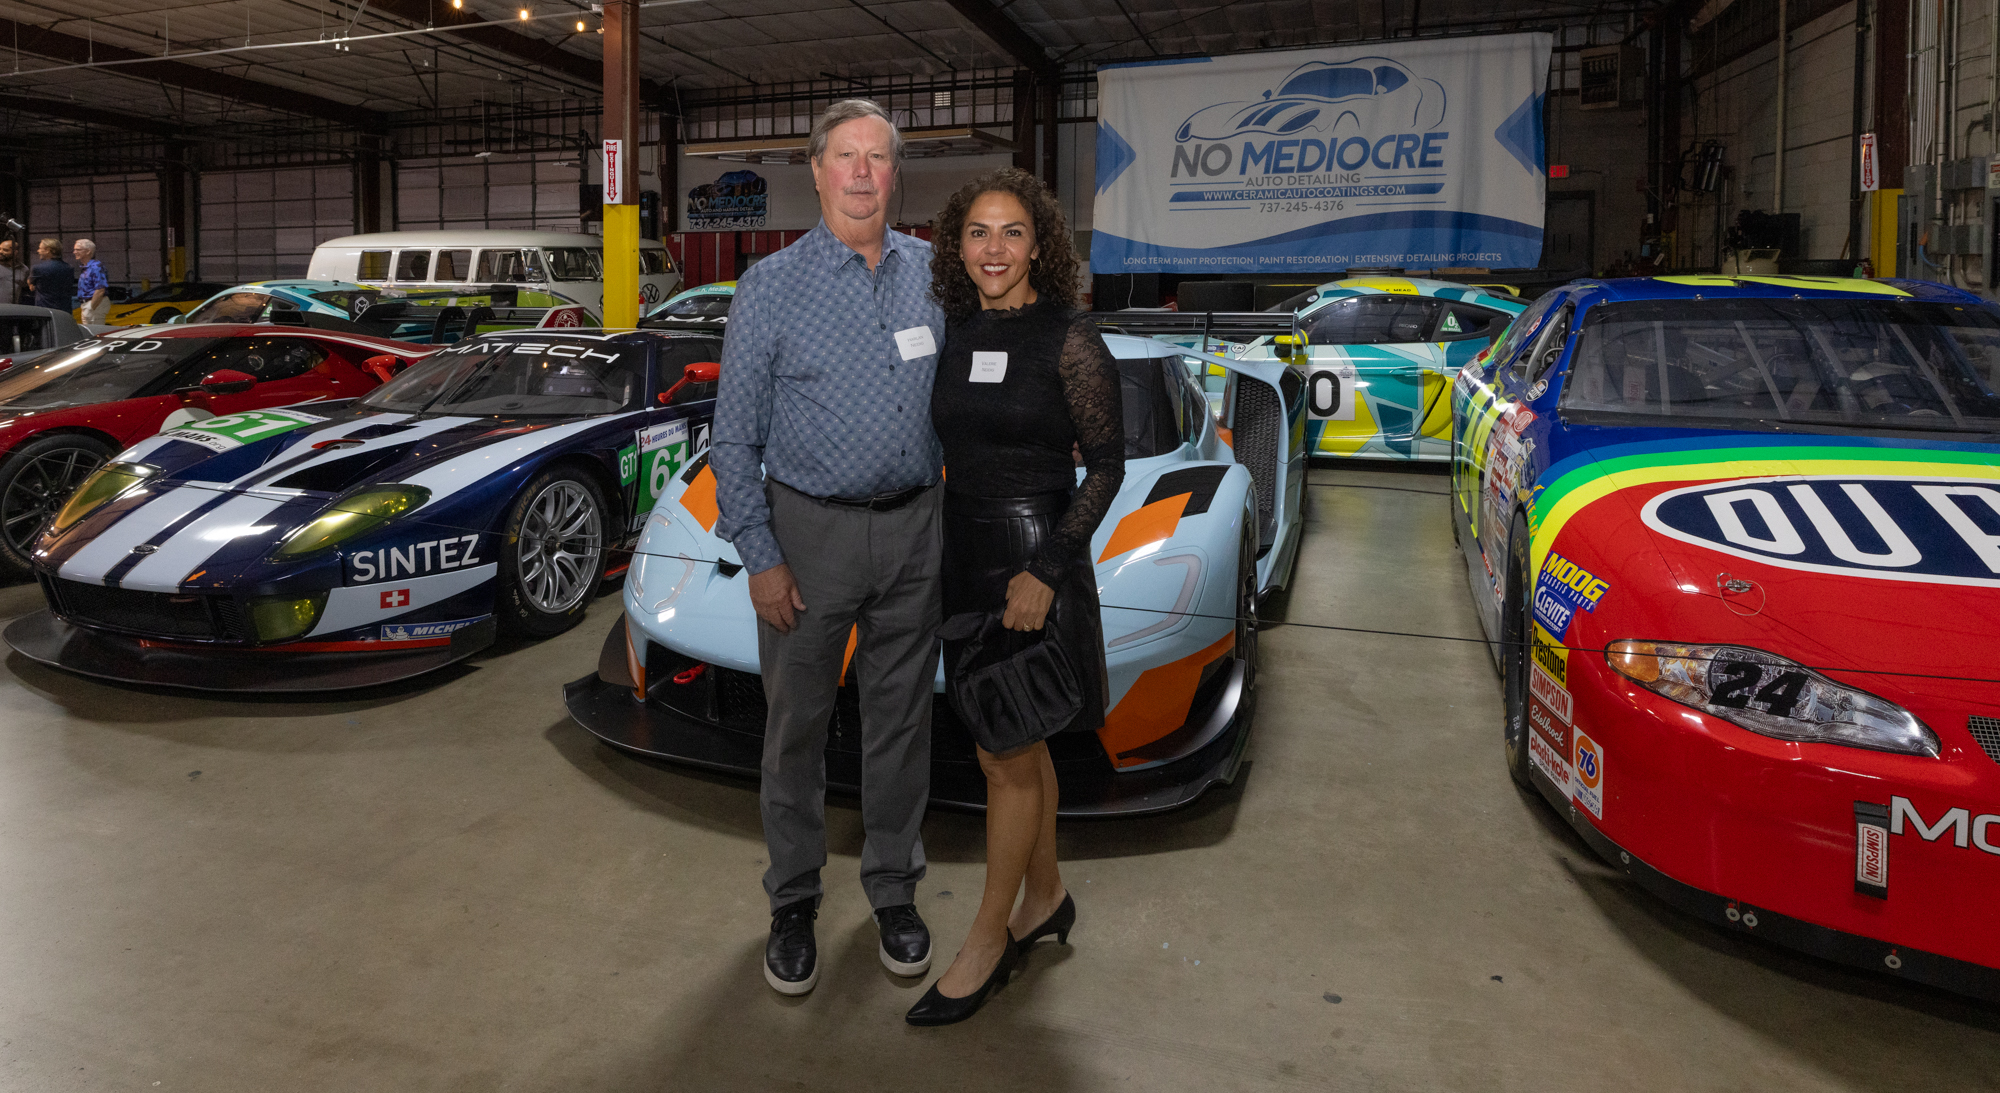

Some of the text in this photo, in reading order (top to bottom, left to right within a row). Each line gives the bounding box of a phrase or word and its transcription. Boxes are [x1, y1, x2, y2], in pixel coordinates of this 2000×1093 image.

[1170, 132, 1449, 178] NO MEDIOCRE
[1245, 172, 1361, 187] AUTO DETAILING
[1550, 165, 1567, 177] EXIT
[688, 194, 768, 210] NO MEDIOCRE
[1203, 185, 1406, 201] WWW.CERAMICAUTOCOATINGS.COM
[1259, 200, 1344, 213] 737-245-4376
[690, 215, 766, 229] 737-245-4376
[1123, 256, 1254, 265] LONG TERM PAINT PROTECTION
[1259, 255, 1349, 265] PAINT RESTORATION
[1354, 252, 1502, 263] EXTENSIVE DETAILING PROJECTS
[436, 342, 621, 364] MATECH
[191, 411, 299, 438] 61
[652, 430, 668, 443] HEURES
[668, 427, 675, 436] DU
[675, 422, 687, 433] MANS
[620, 452, 637, 479] GT1
[650, 442, 687, 499] 61
[353, 534, 480, 582] SINTEZ
[1541, 571, 1595, 611] CHASSIS PARTS
[1542, 552, 1610, 603] MOOG
[1534, 586, 1571, 628] CLEVITE
[1531, 624, 1566, 684] Prestone
[1531, 667, 1569, 719] SIMPSON
[1708, 662, 1810, 717] 24
[1530, 704, 1565, 748] Edelbrock
[1577, 746, 1597, 780] 76
[1574, 776, 1600, 804] OFFICIAL FUEL
[1866, 829, 1880, 879] SIMPSON
